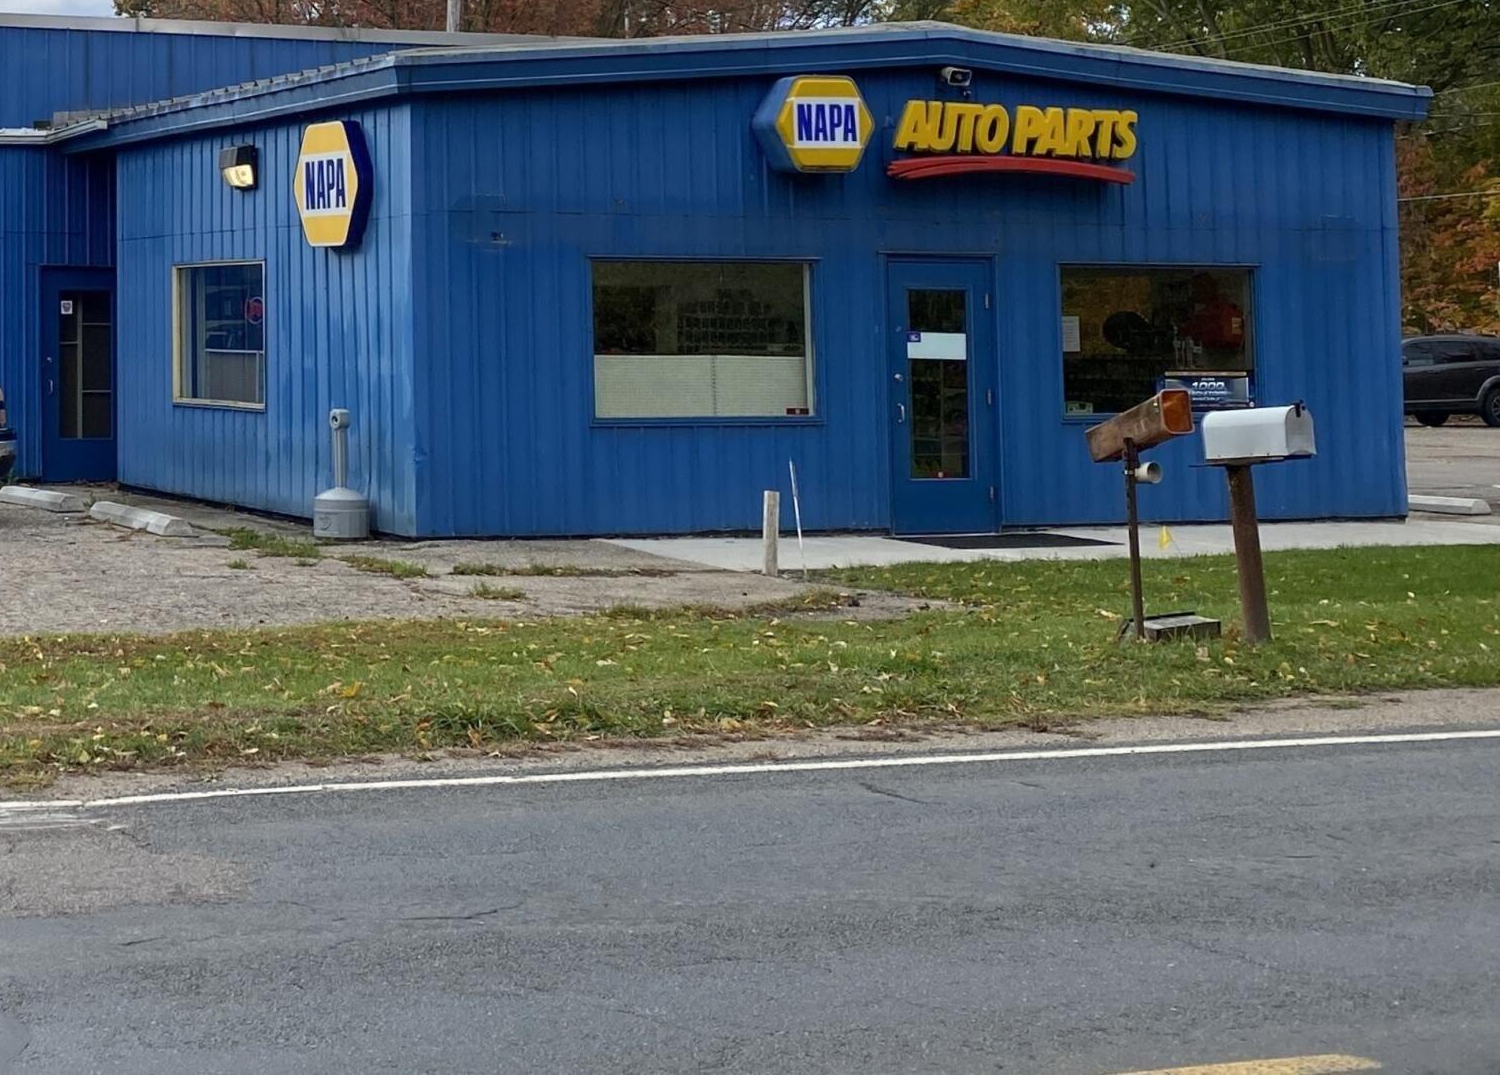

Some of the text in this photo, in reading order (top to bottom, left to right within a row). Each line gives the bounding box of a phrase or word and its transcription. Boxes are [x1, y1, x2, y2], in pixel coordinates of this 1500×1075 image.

[797, 100, 1138, 159] NAPA AUTO PARTS
[305, 158, 346, 210] NAPA
